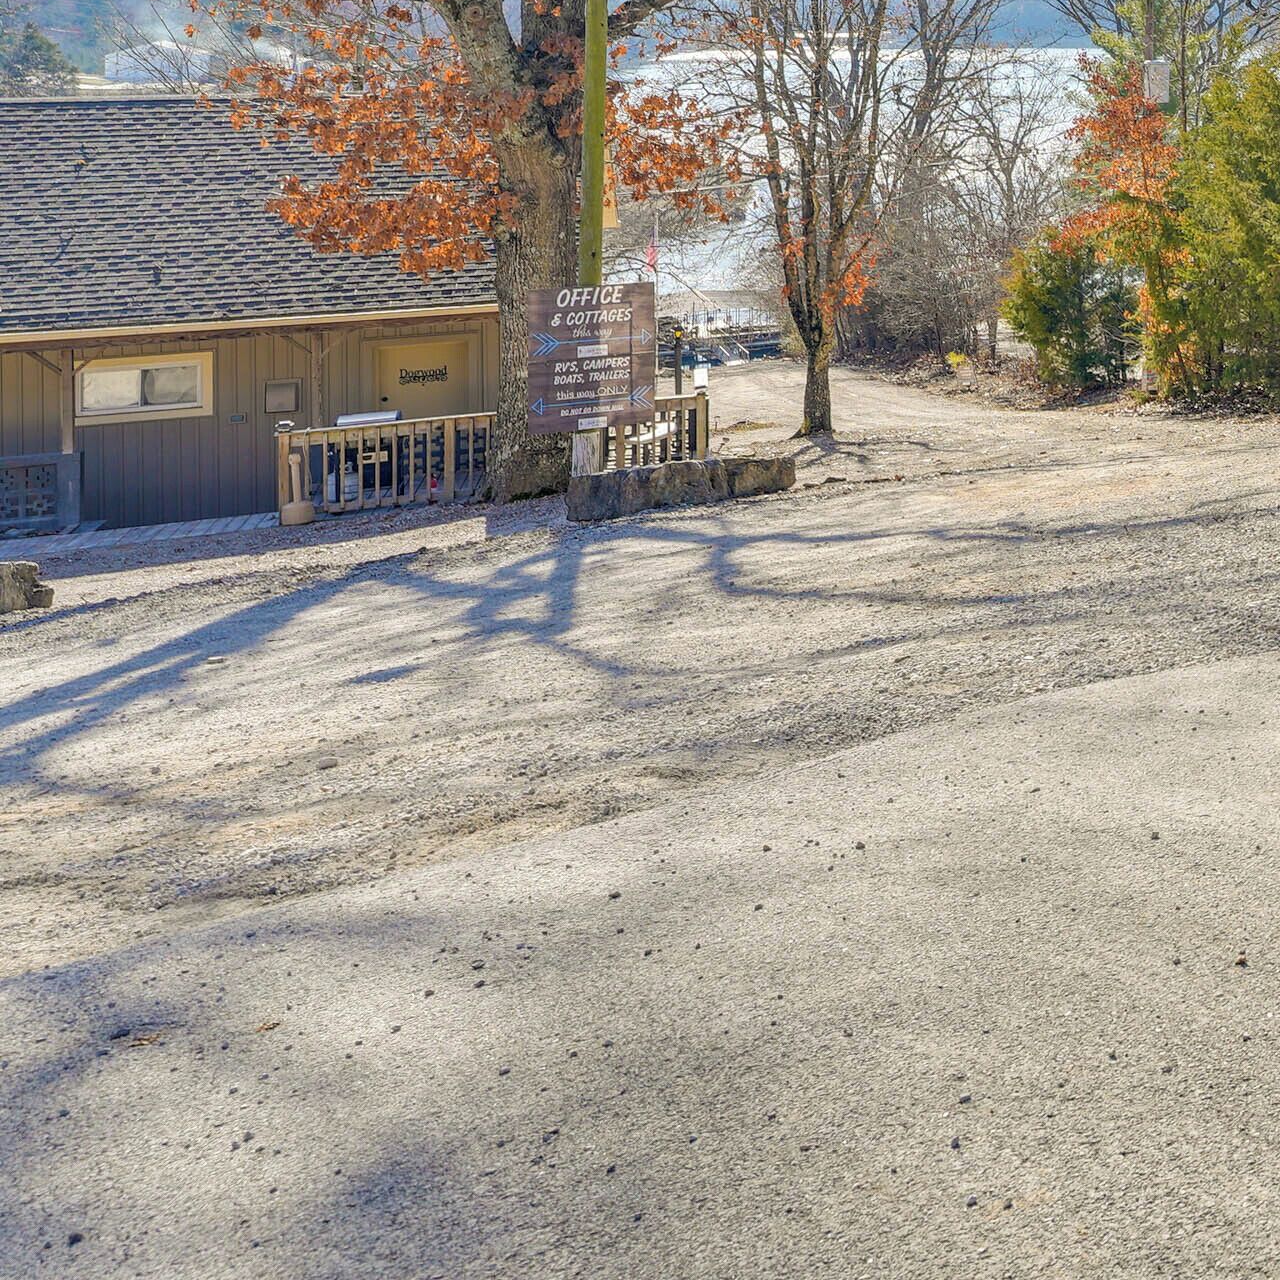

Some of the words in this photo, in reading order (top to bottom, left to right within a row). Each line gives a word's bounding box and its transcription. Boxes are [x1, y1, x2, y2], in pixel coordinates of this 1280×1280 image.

[556, 285, 624, 308] OFFICE
[550, 313, 563, 327] &
[566, 307, 633, 326] COTTAGES
[572, 324, 592, 337] this
[583, 356, 631, 370] CAMPERS
[399, 365, 448, 379] Dogwood
[553, 373, 585, 386] BOATS,
[588, 369, 631, 382] TRAILERS
[556, 390, 575, 400] this
[576, 390, 596, 399] way
[596, 385, 628, 397] ONLY
